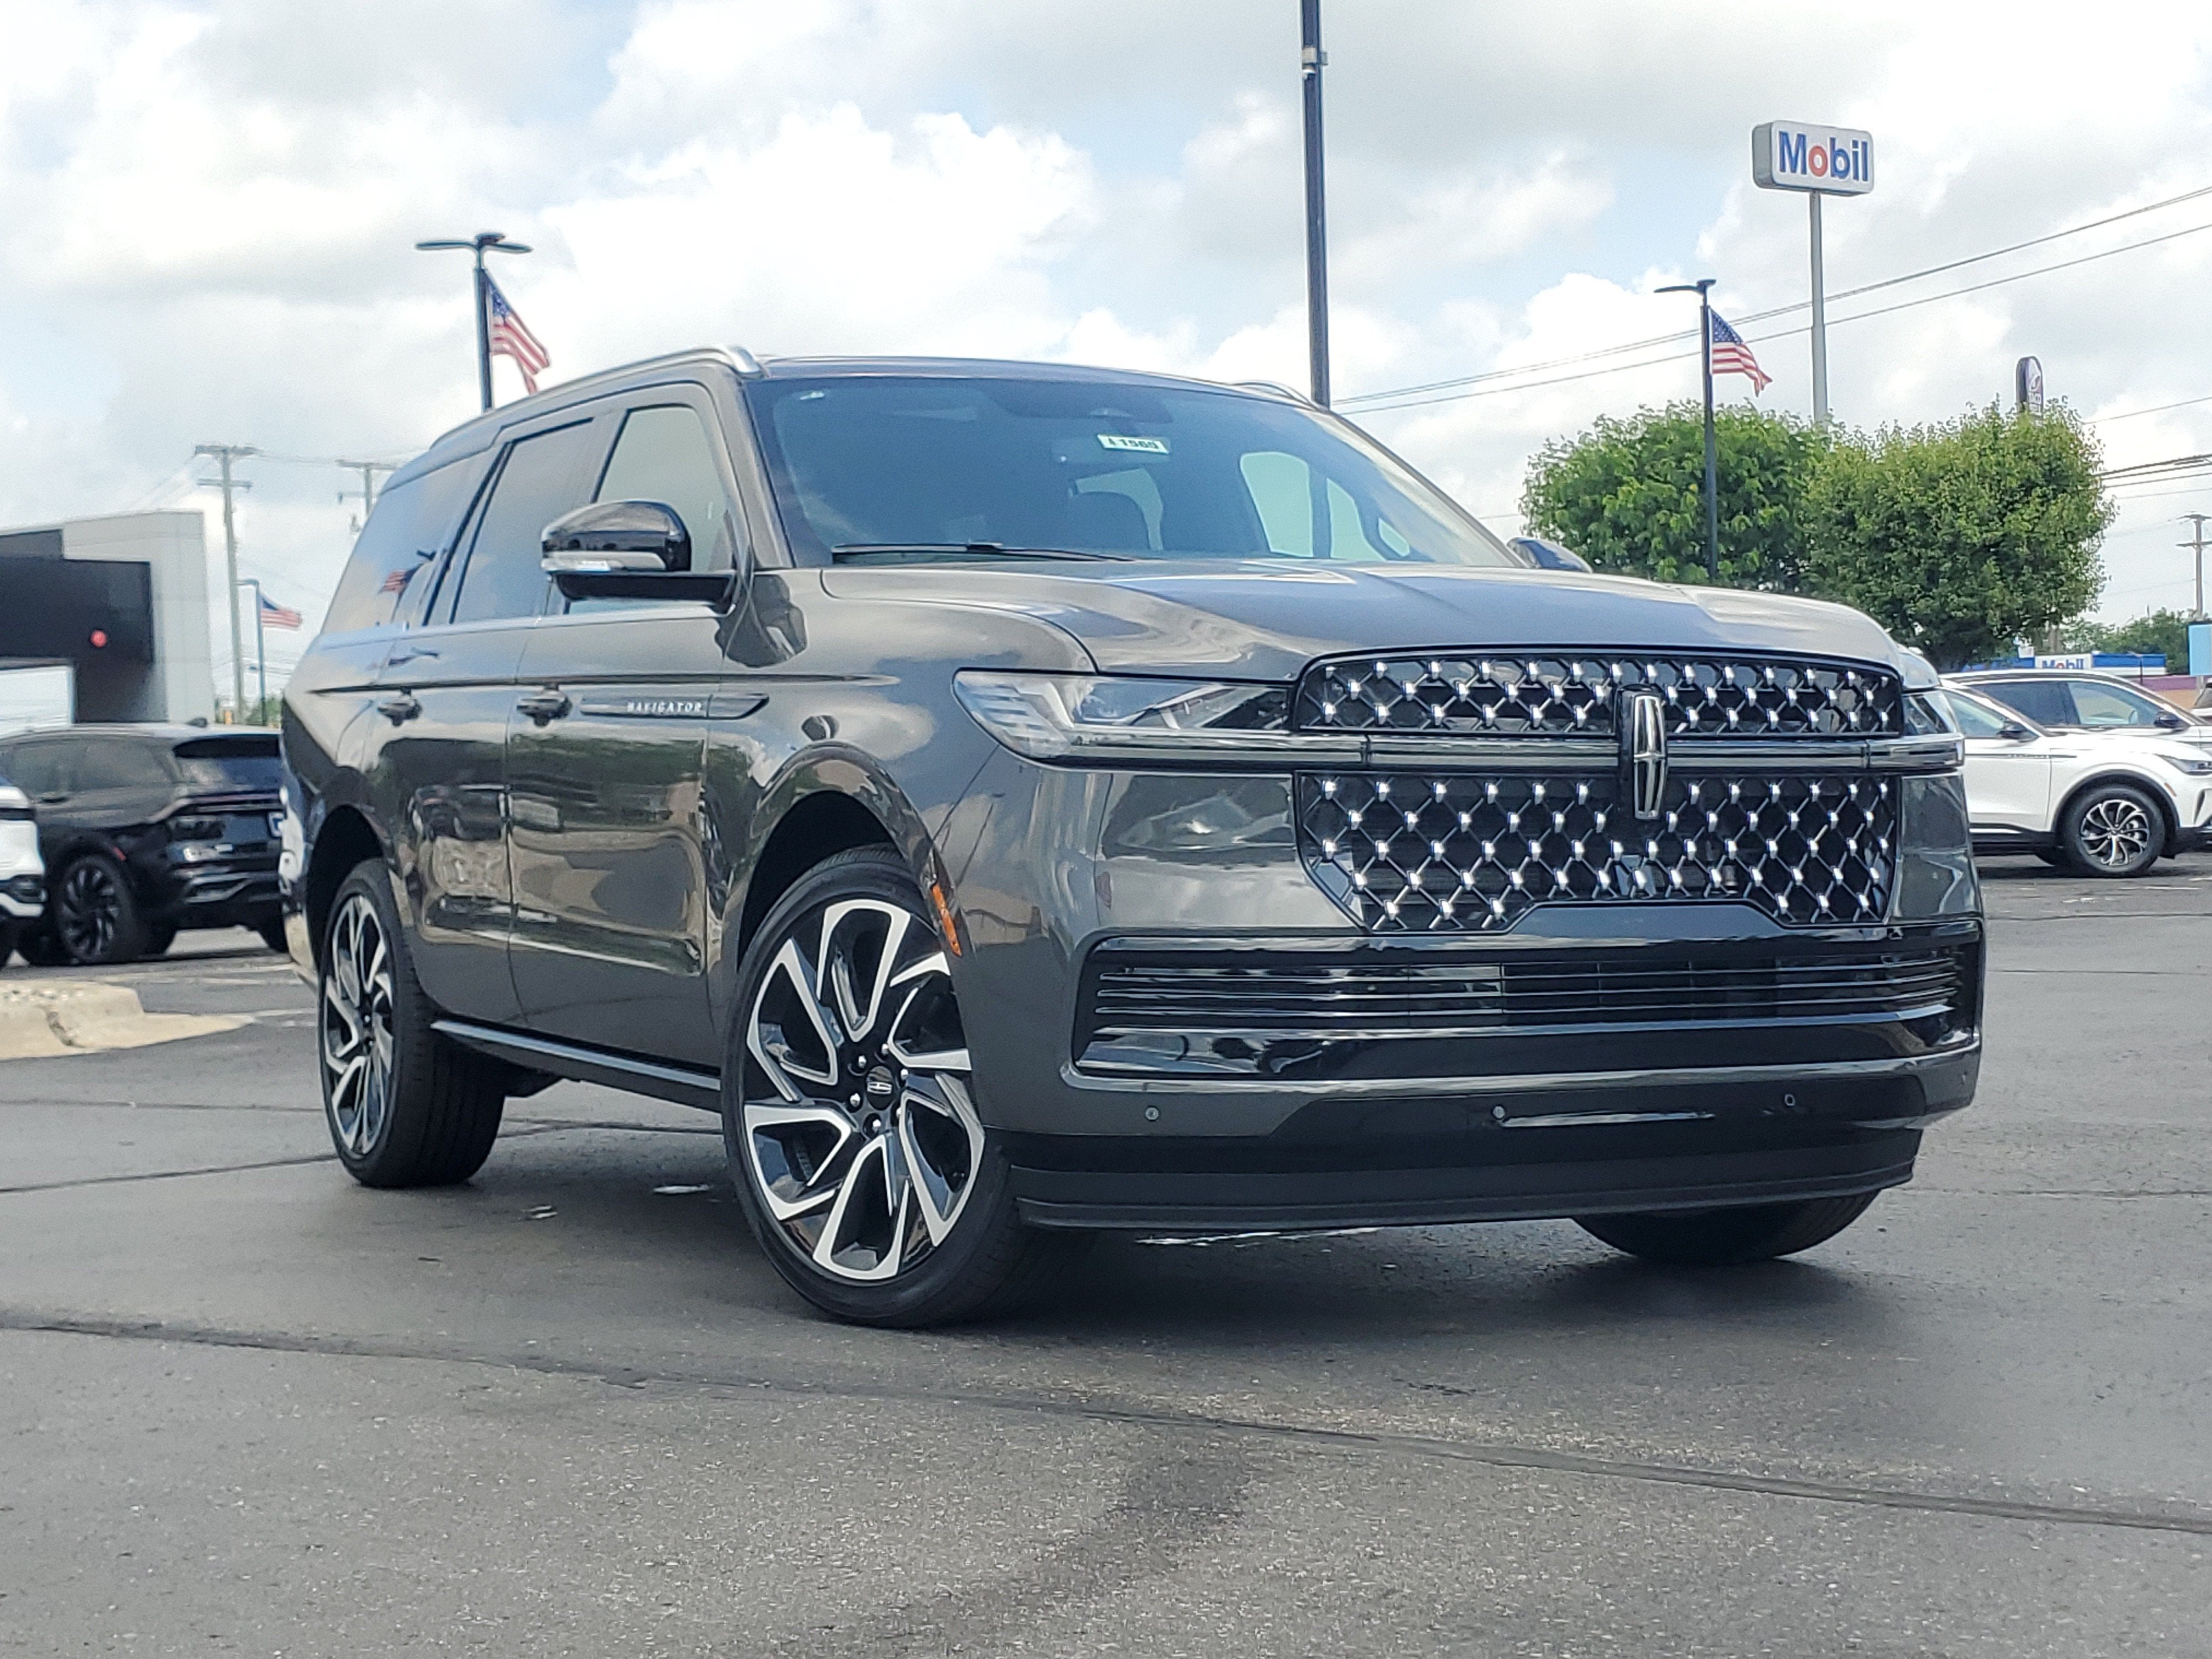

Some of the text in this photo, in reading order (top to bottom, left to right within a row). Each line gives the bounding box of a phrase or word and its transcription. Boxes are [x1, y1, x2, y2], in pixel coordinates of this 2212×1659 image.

[1779, 131, 1868, 182] Mobil
[2042, 658, 2084, 669] Mobil
[627, 701, 702, 713] NAVIGATOR
